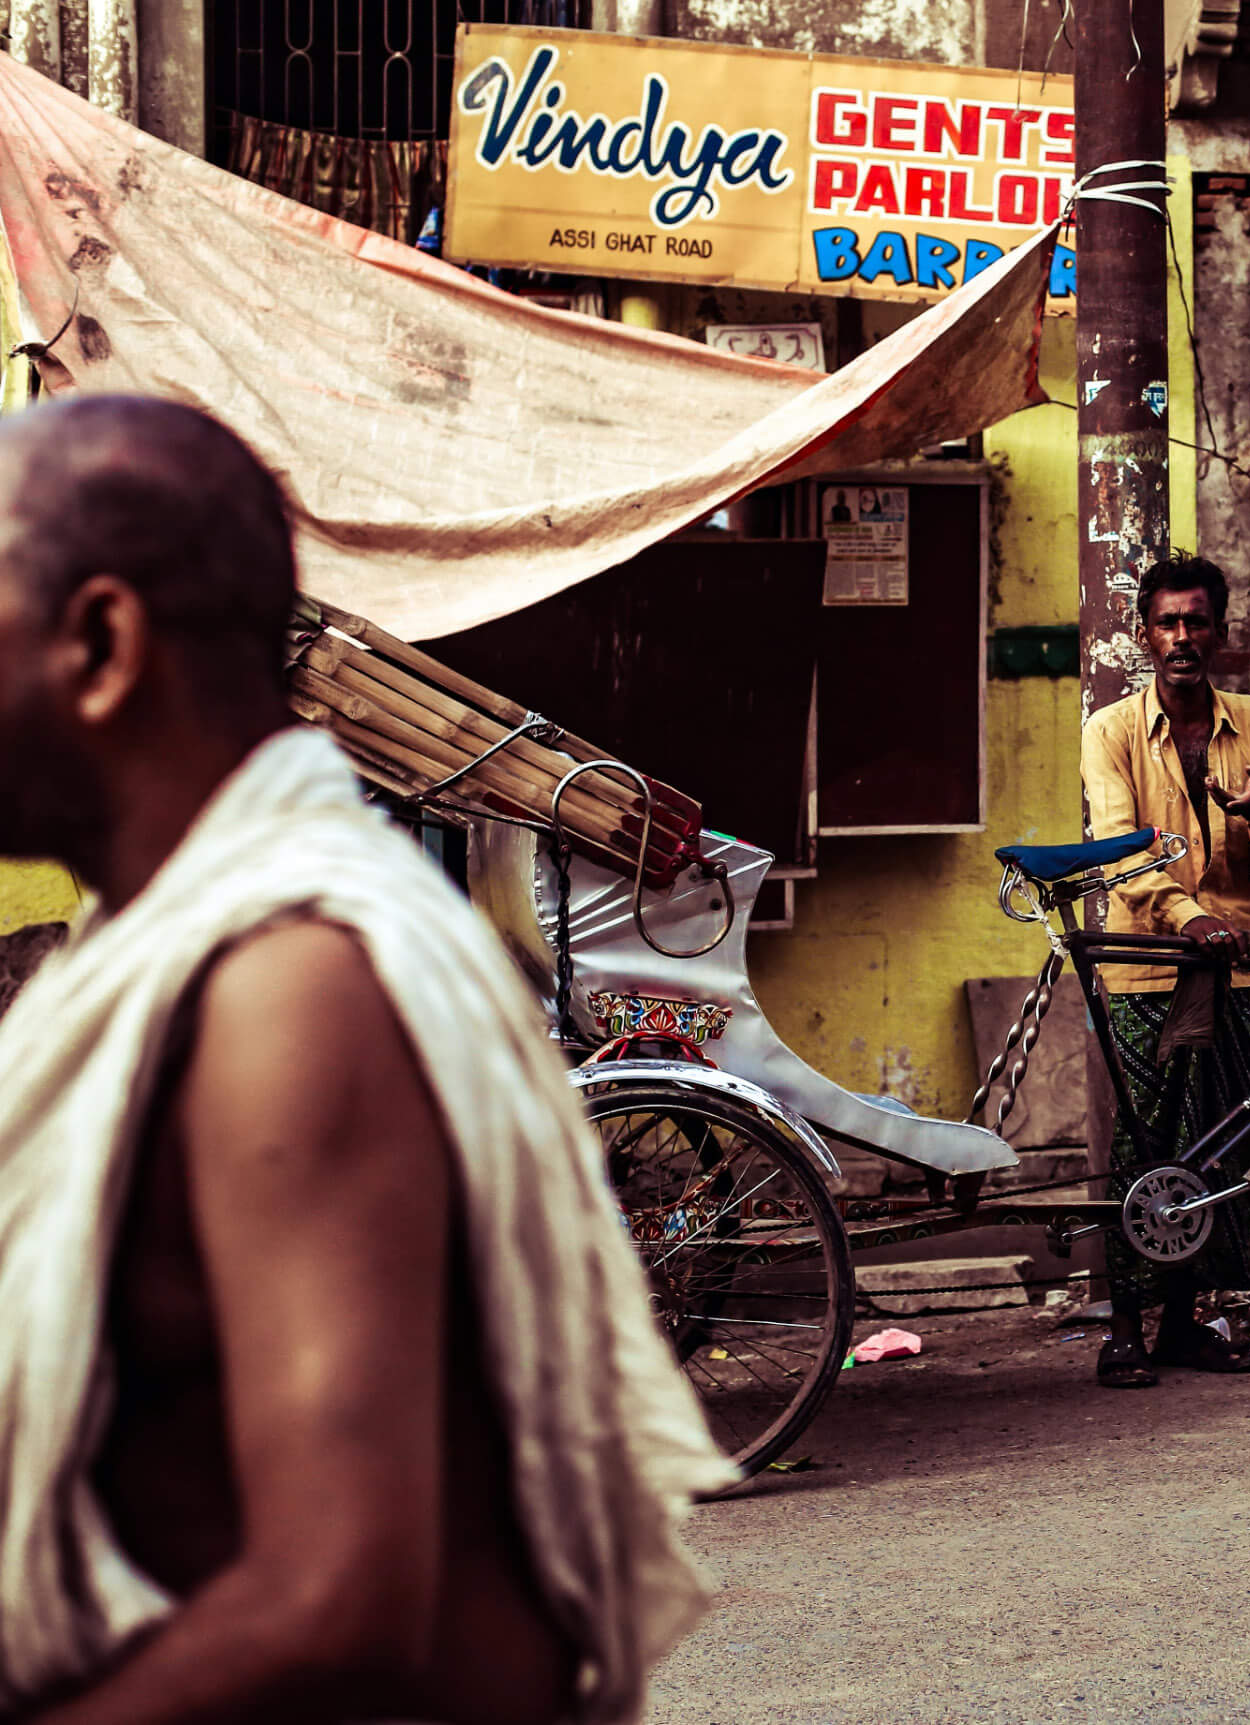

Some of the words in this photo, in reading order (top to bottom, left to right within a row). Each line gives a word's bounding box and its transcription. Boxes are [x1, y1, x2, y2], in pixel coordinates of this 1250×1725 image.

[461, 47, 790, 227] Vindya
[814, 91, 1076, 163] GENTS
[812, 158, 1077, 227] PARLOU
[549, 228, 596, 249] ASSI
[604, 231, 658, 254] GHAT
[666, 236, 713, 259] ROAD
[812, 226, 1077, 298] BARBR
